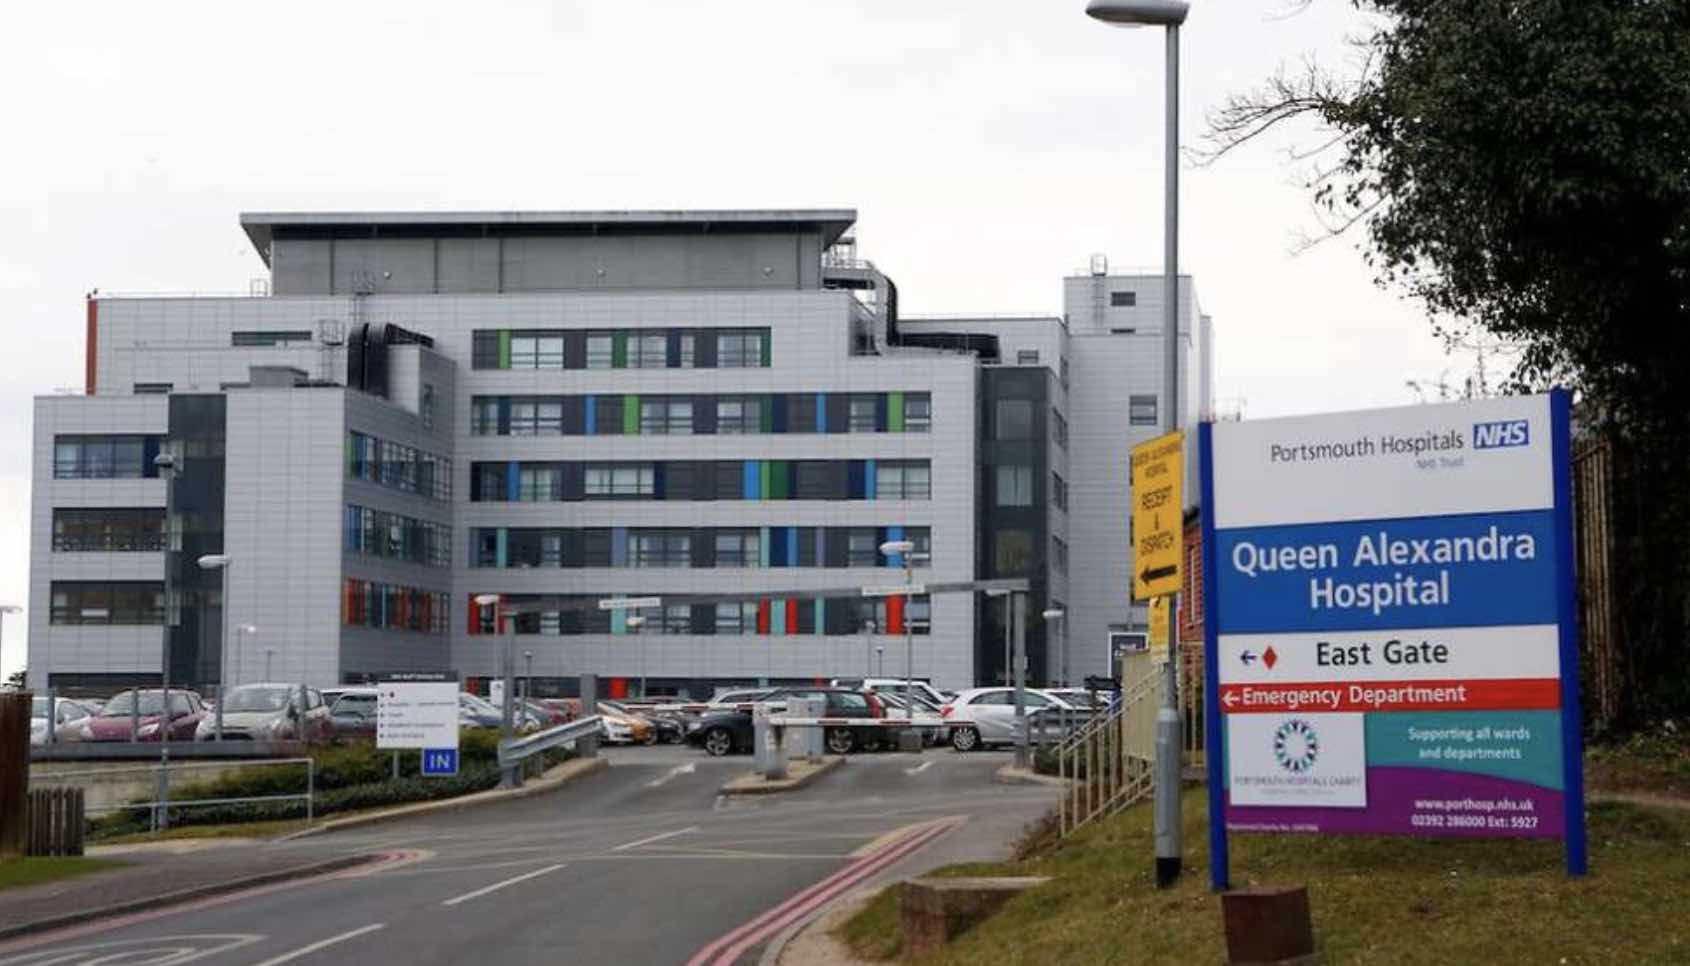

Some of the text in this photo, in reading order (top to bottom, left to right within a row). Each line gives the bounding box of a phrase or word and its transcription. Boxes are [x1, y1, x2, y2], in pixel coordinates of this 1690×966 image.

[1271, 421, 1528, 462] Portsmouth Hospitals NHS
[1233, 526, 1536, 577] Queen Alexandra
[1310, 571, 1449, 615] Hospital
[1316, 640, 1449, 667] East Gate
[1242, 685, 1467, 709] Emergency Department
[1408, 725, 1531, 742] Supporting all wards
[429, 754, 450, 768] IN
[1419, 746, 1521, 763] and departments
[1414, 797, 1535, 812] www.porthosp.nhs.uk
[1487, 816, 1509, 828] Ext:
[1511, 816, 1539, 828] 5927
